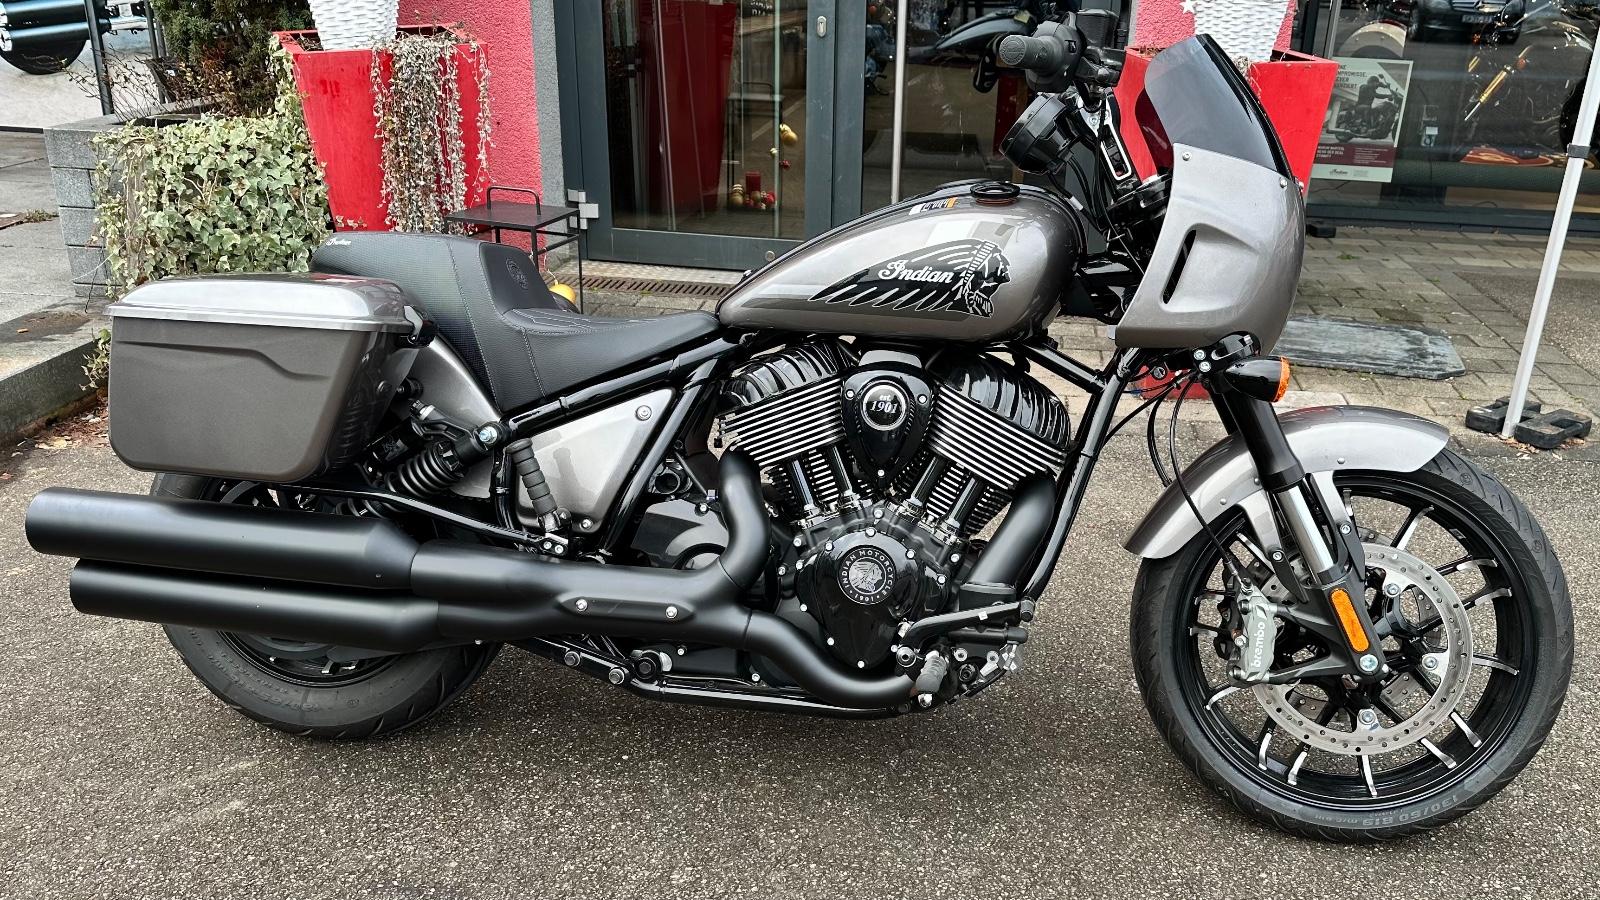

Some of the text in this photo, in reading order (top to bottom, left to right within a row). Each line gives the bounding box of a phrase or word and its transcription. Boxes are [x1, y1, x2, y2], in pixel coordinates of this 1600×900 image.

[878, 259, 954, 284] Indian
[870, 400, 898, 413] 1901
[841, 549, 894, 596] INDIAN MOTORCYCLE
[1251, 621, 1266, 668] brembo
